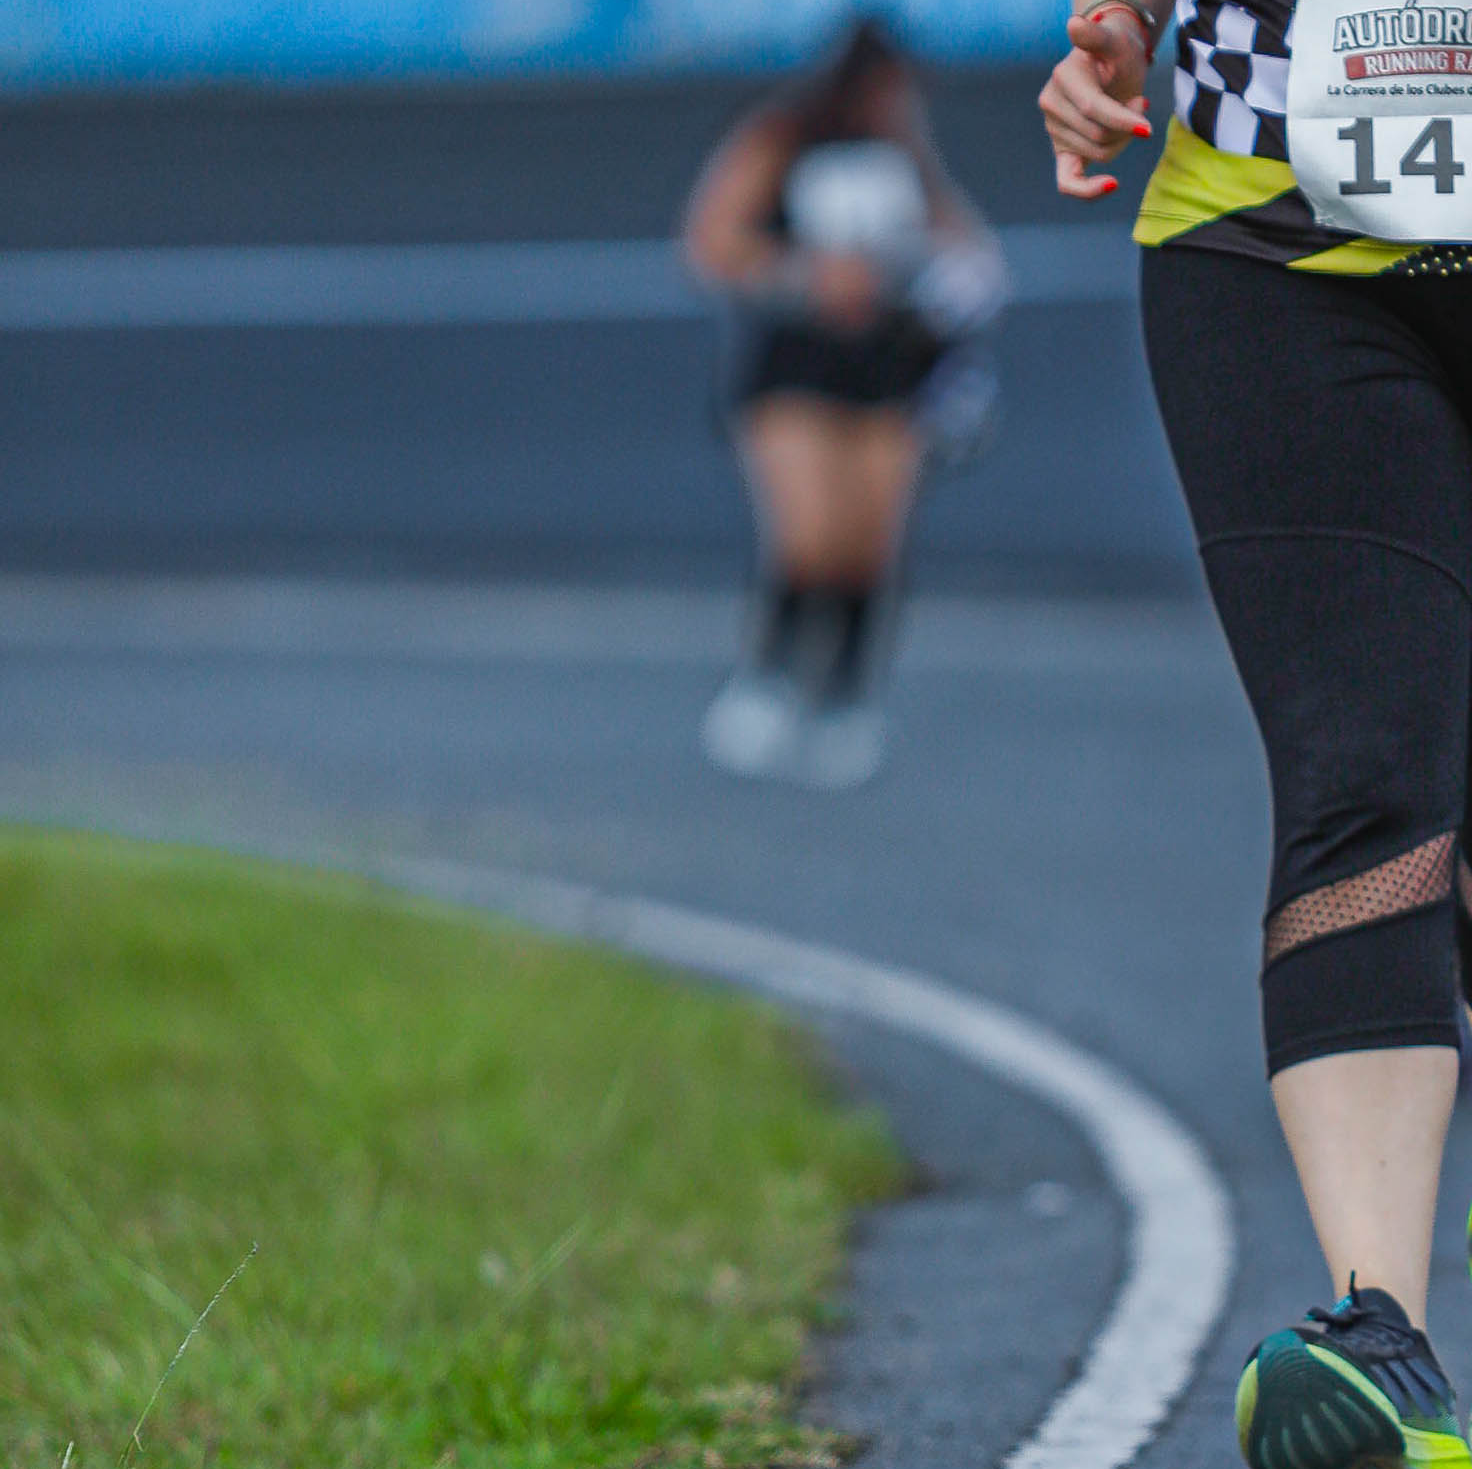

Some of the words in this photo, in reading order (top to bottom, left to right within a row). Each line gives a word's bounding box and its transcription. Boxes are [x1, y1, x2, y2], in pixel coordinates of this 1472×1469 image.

[1364, 51, 1449, 75] RUNNING
[1327, 84, 1340, 95] La
[1344, 84, 1386, 95] Carrera
[1389, 84, 1404, 95] de
[1407, 84, 1424, 95] los
[1426, 84, 1465, 95] Clubes
